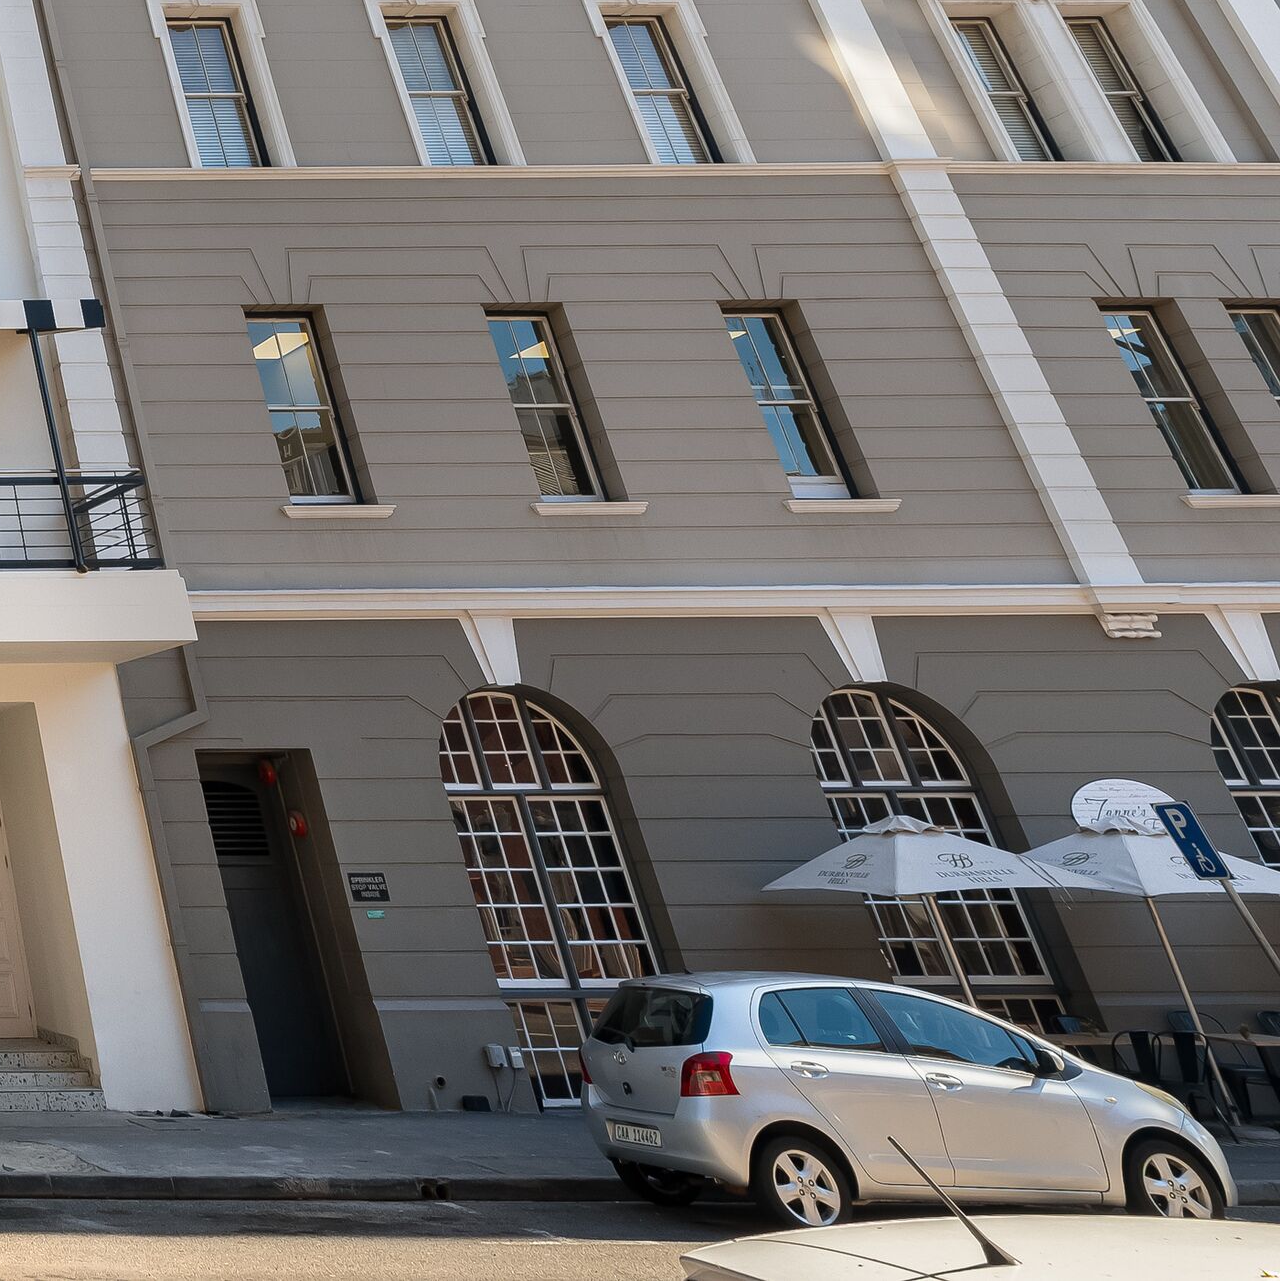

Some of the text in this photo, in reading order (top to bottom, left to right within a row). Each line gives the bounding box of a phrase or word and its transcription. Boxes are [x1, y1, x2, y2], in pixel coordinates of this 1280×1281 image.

[1164, 808, 1188, 840] P
[817, 869, 871, 879] DURBANVILLE
[937, 867, 1018, 879] DURBANVILLE
[826, 877, 850, 885] HILLS
[966, 875, 1003, 885] HILLS
[351, 883, 387, 891] STOP VALVE
[616, 1124, 630, 1141] CAA
